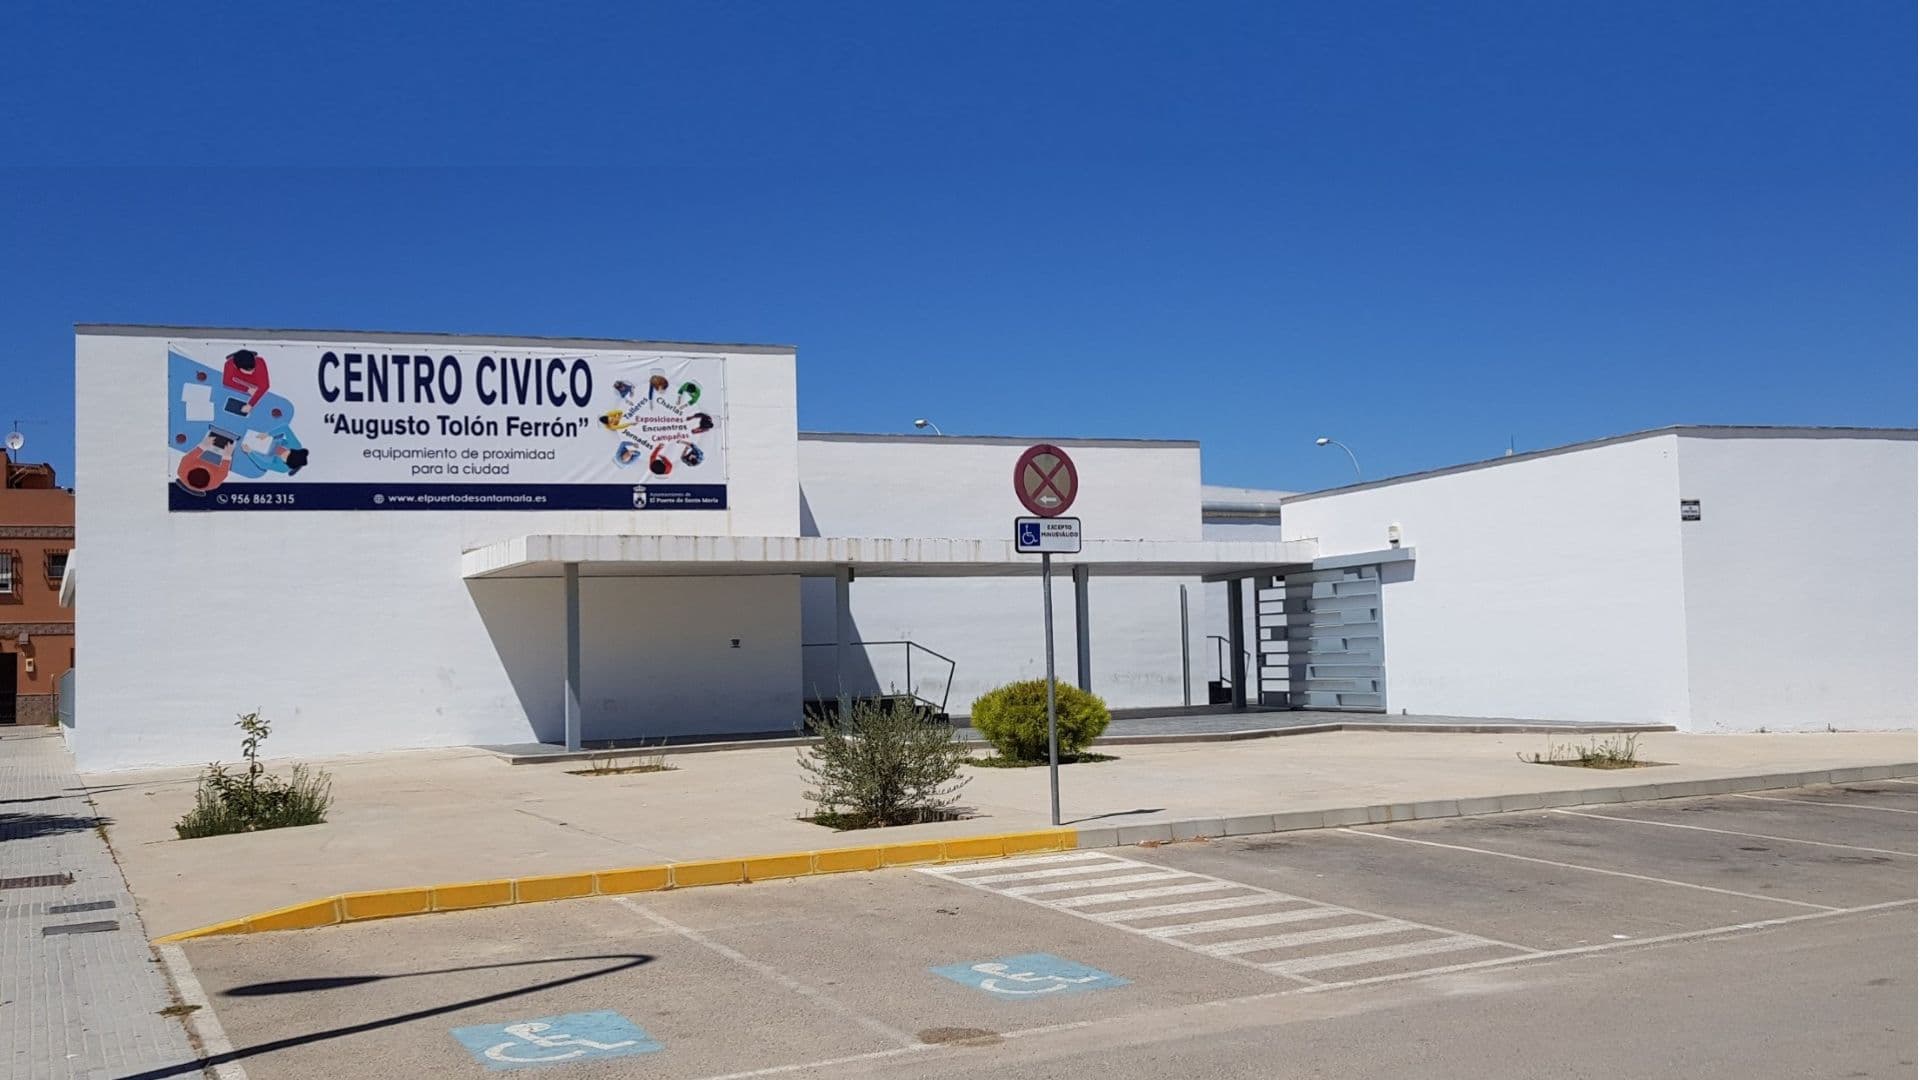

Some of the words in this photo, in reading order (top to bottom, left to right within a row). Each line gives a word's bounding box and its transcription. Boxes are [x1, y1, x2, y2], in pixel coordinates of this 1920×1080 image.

[318, 351, 462, 405] CENTRO
[476, 356, 593, 408] CIVICO
[623, 397, 649, 420] Talleres
[656, 396, 684, 416] Charlas
[635, 415, 684, 424] Exposiciones
[323, 413, 430, 440] “Augusto
[437, 415, 498, 436] Tolón
[506, 416, 589, 438] Ferrón”
[642, 424, 688, 432] Encuentros
[622, 428, 654, 450] Jornadas
[651, 433, 690, 442] Campañas
[363, 447, 456, 459] equipamiento
[461, 448, 479, 460] de
[483, 449, 555, 461] proximidad
[411, 464, 443, 476] para
[447, 463, 459, 475] la
[463, 463, 510, 475] ciudad
[231, 494, 250, 504] 956
[253, 494, 273, 504] 862
[275, 494, 295, 504] 315
[388, 494, 548, 504] www.elpuertodesantamaria.es
